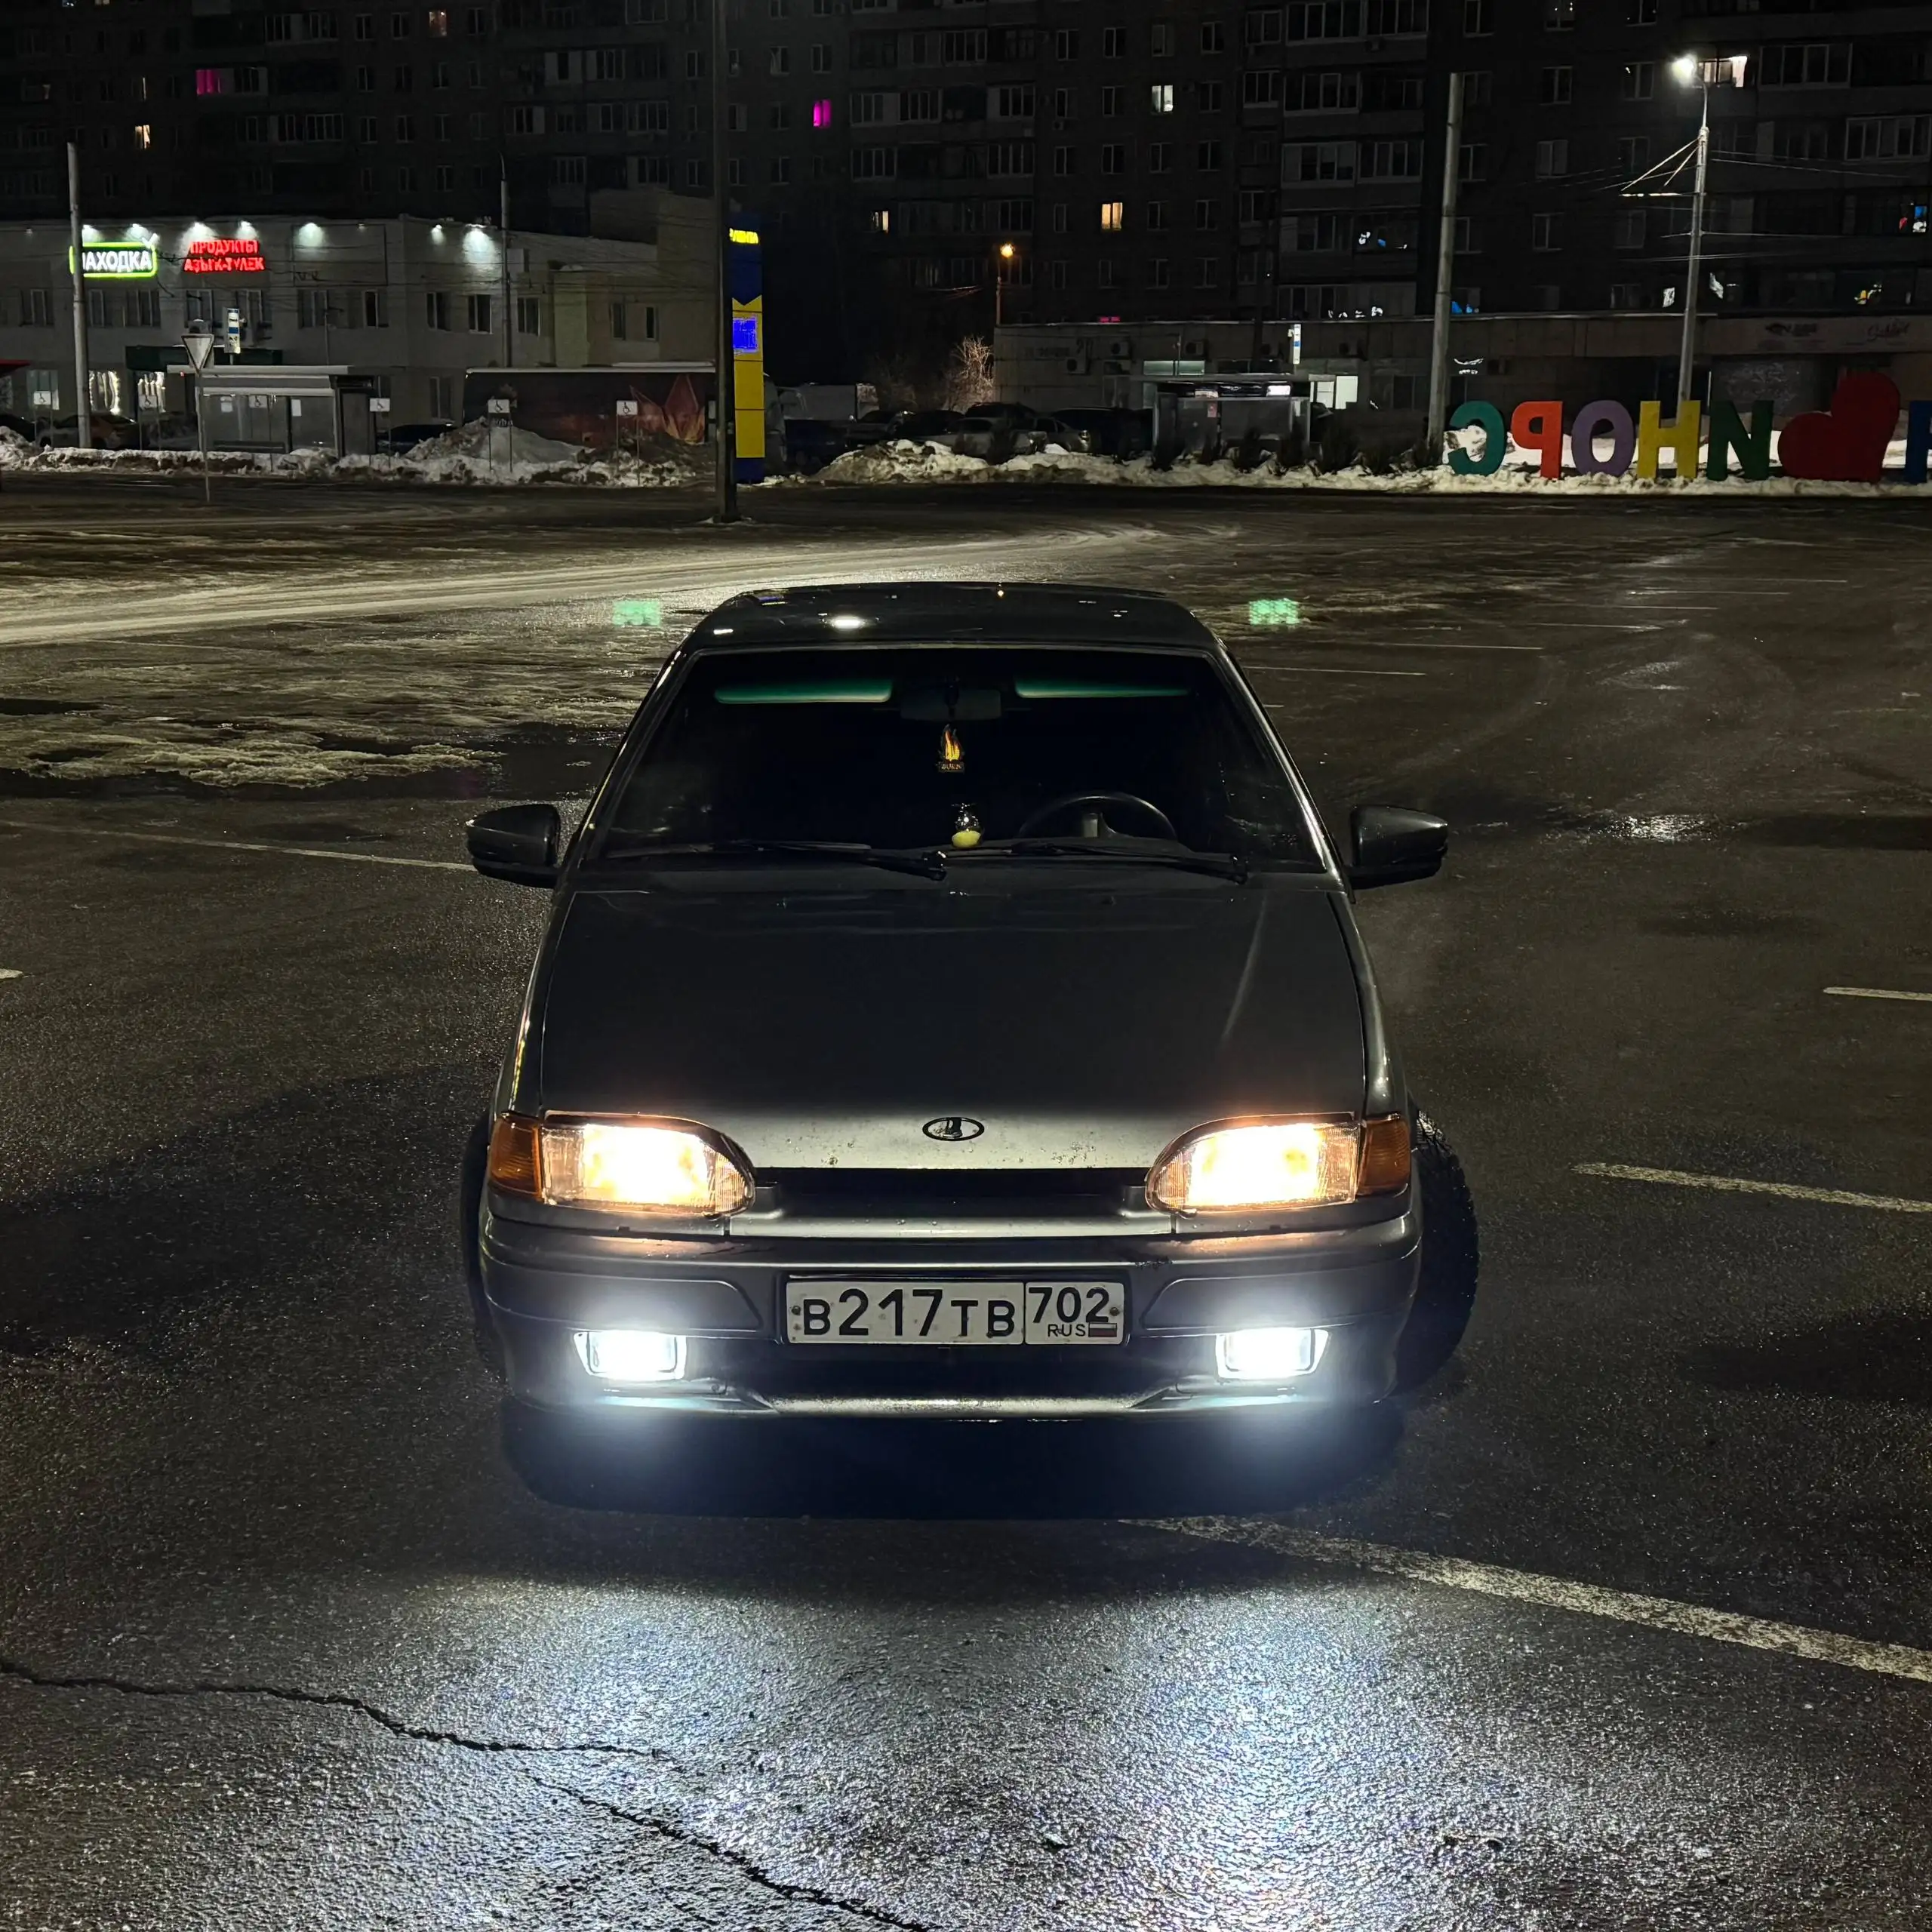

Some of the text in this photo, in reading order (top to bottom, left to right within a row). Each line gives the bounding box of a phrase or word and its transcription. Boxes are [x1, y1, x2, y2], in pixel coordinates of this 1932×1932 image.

[190, 240, 258, 255] ПРОДУКТЫ
[1028, 1287, 1110, 1324] 702
[1048, 1324, 1086, 1337] RUS
